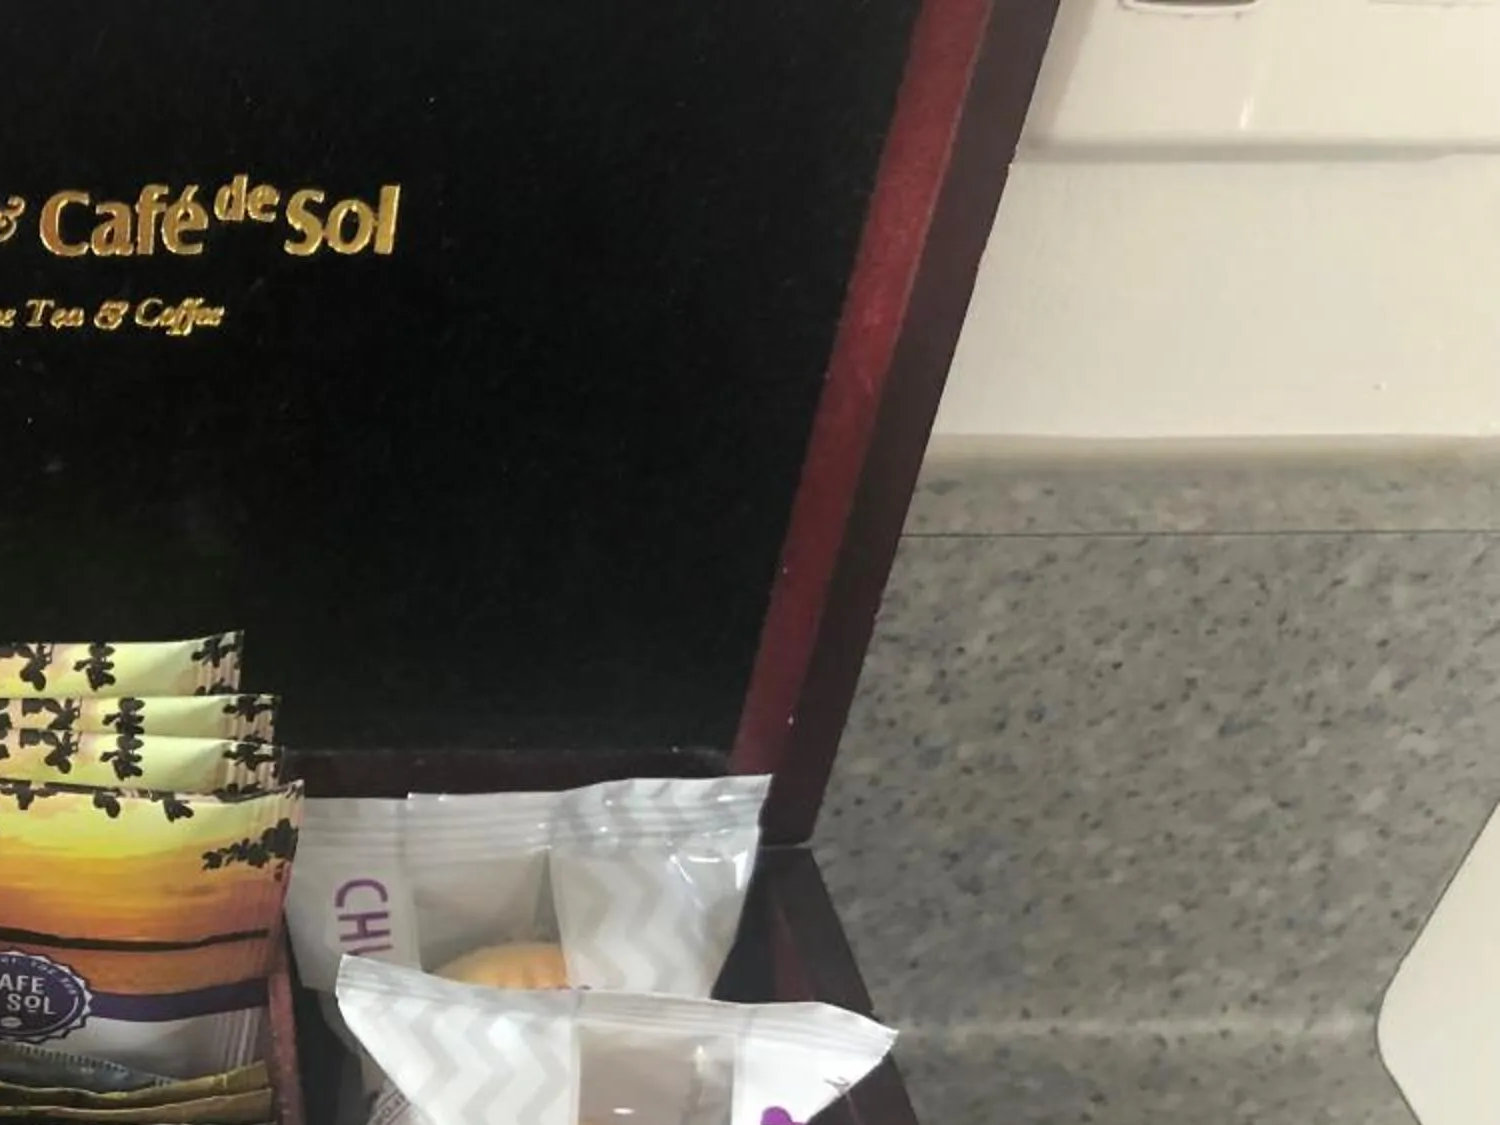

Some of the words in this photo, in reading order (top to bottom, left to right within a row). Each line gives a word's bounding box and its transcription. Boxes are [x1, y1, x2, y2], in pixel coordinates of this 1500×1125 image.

[40, 184, 209, 257] Café
[215, 174, 280, 222] de
[284, 184, 400, 257] Sol
[26, 299, 84, 330] Tea
[93, 302, 129, 331] &
[135, 298, 225, 336] Coffee
[6, 993, 57, 1015] SOL
